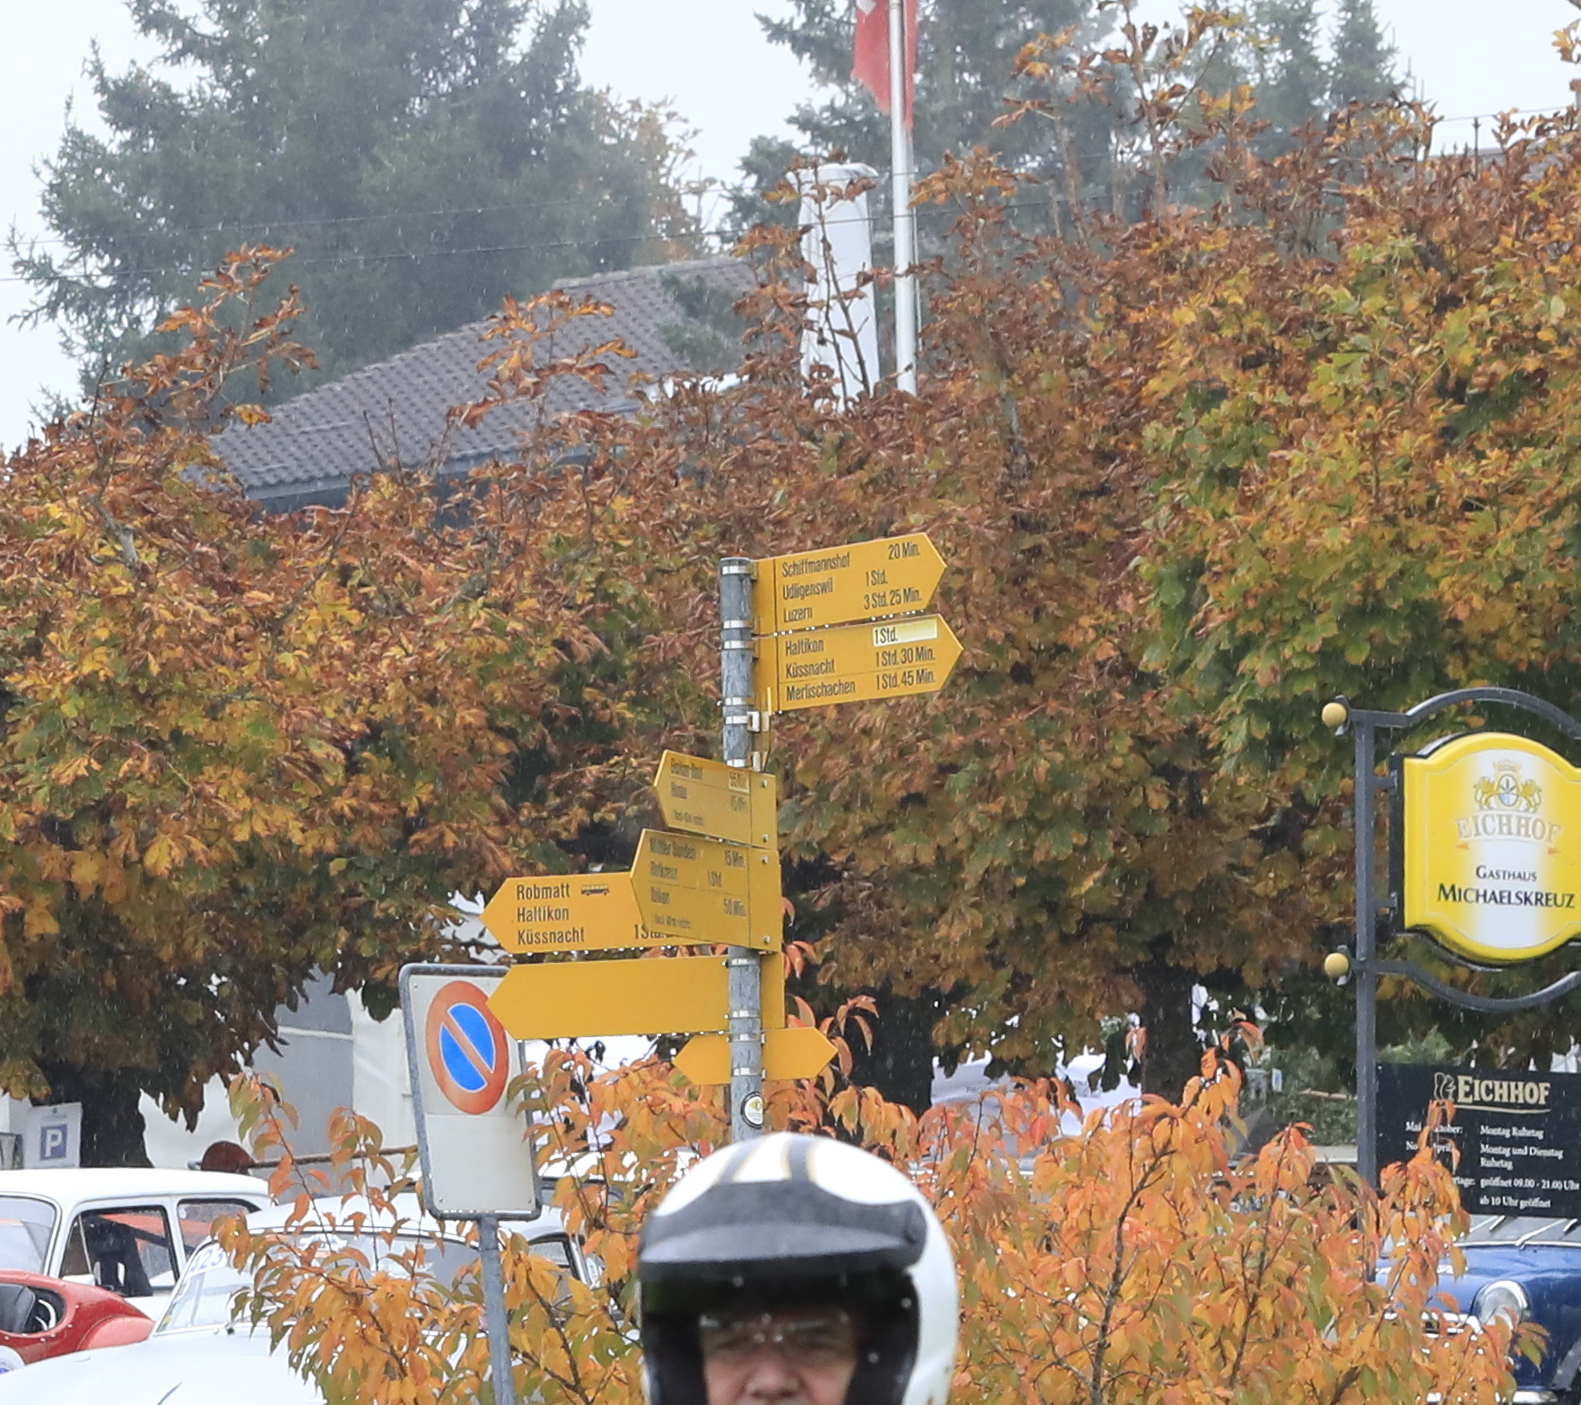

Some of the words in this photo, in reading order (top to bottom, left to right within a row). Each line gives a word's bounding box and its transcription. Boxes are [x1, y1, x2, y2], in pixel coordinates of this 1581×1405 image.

[782, 552, 850, 577] Schiffmannshof
[889, 545, 900, 560] 20
[902, 541, 920, 557] Min.
[783, 578, 833, 600] Udligenswil
[871, 570, 888, 585] Std.
[784, 607, 813, 623] Luzern
[864, 595, 870, 609] 3
[871, 592, 888, 608] Std.
[890, 590, 902, 605] 25
[903, 588, 921, 603] Min.
[786, 639, 824, 656] Haltikon
[880, 628, 898, 643] Std.
[786, 658, 835, 679] Küssnacht
[881, 651, 899, 667] Std.
[901, 650, 914, 663] 30
[915, 647, 935, 662] Min.
[787, 680, 856, 701] Merlischachen
[882, 674, 899, 690] Std.
[901, 673, 914, 686] 45
[916, 670, 935, 685] Min.
[1456, 813, 1561, 844] EICHHOF
[516, 883, 570, 901] Robmatt
[517, 906, 569, 923] Haltikon
[518, 928, 585, 946] Küssnacht
[1457, 1075, 1551, 1105] EICHHOF
[44, 1128, 62, 1158] P
